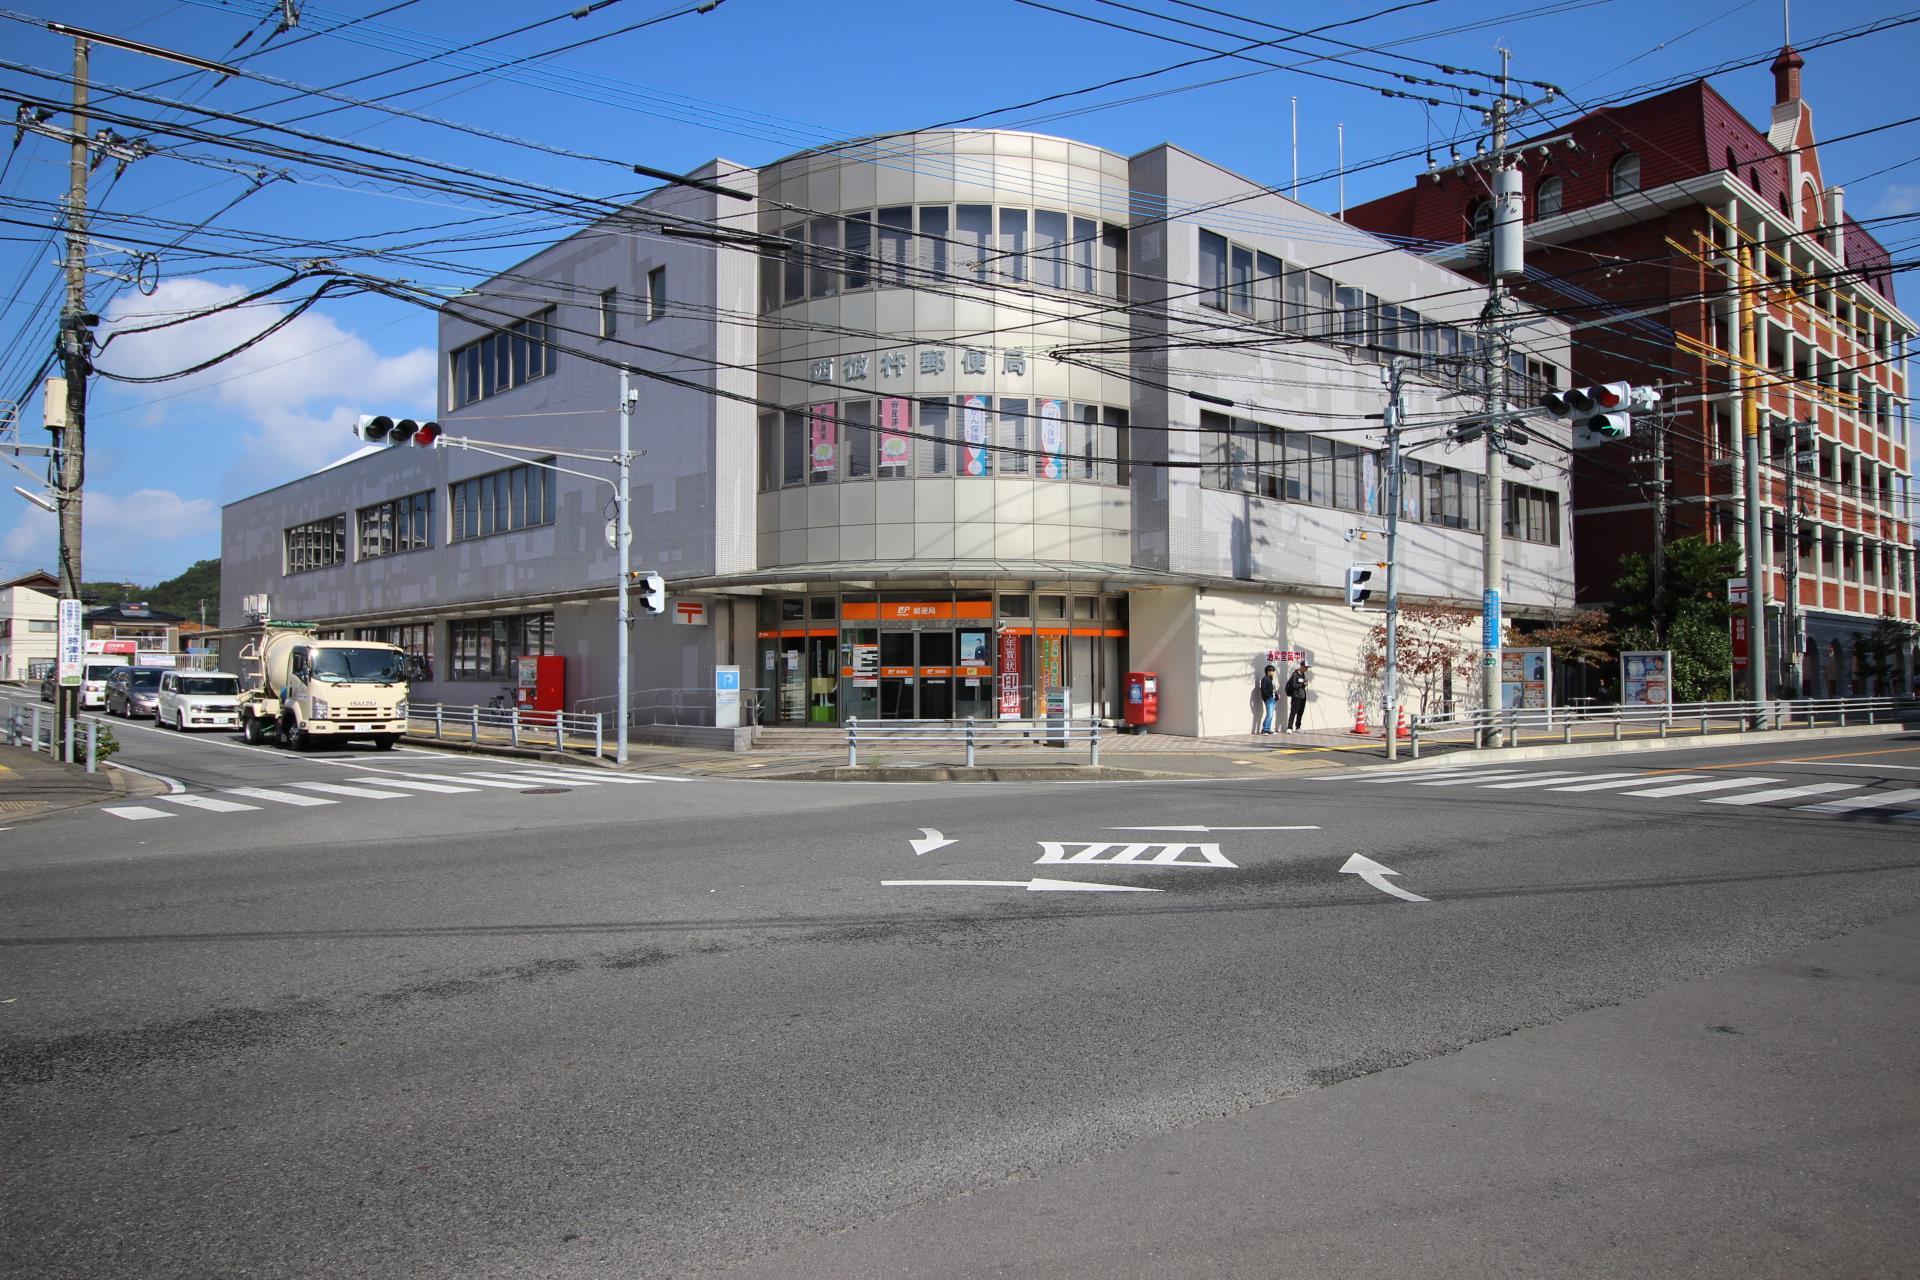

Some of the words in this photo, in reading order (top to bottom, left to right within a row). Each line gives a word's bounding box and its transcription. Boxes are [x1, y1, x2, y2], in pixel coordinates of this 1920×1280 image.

[811, 350, 1026, 385] 西彼杵郵便局
[820, 407, 828, 440] 資運用
[913, 606, 936, 615] 郵便局
[947, 619, 980, 630] OFFICE
[1736, 619, 1745, 641] 郵便局
[1002, 637, 1018, 708] 年賀状印刷
